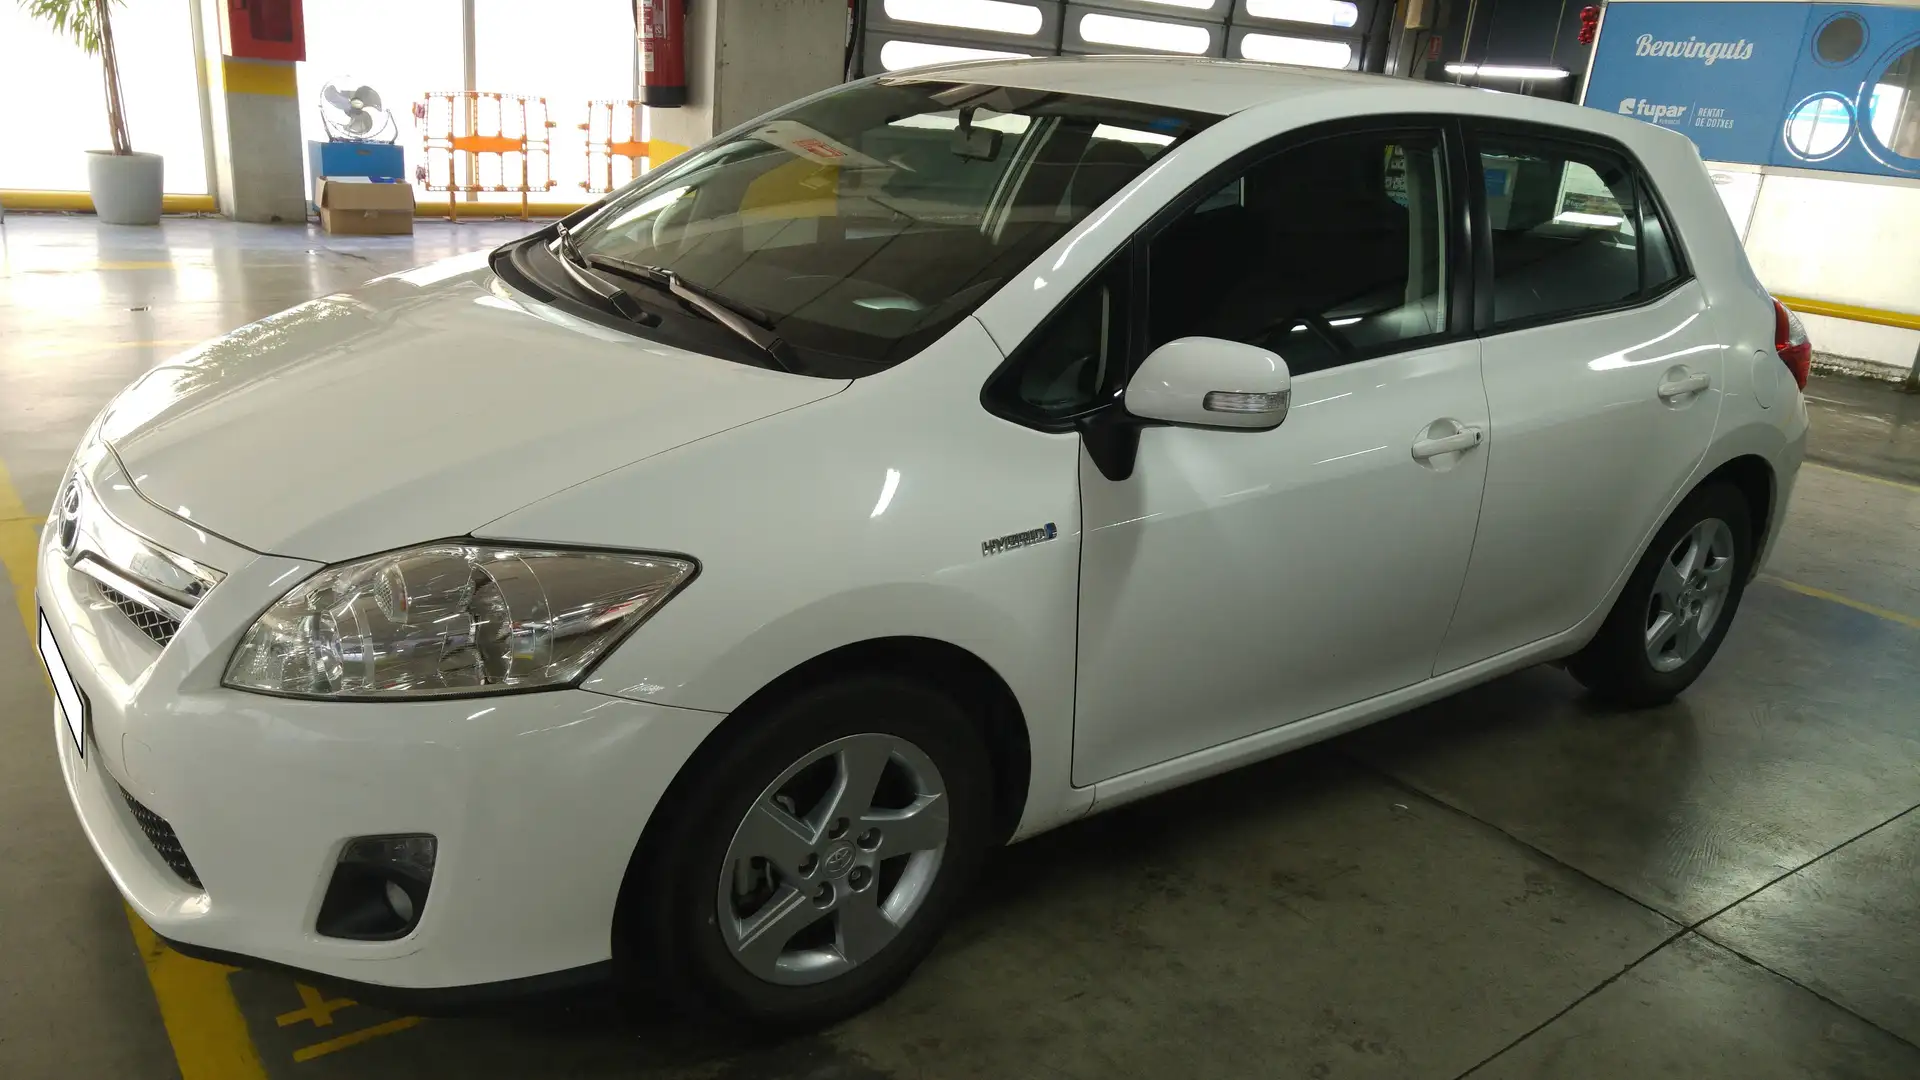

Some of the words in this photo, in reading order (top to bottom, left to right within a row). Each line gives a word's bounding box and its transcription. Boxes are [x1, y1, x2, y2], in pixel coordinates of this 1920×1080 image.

[1635, 33, 1753, 66] Benvinguts
[1637, 98, 1687, 124] fupar
[1695, 118, 1704, 127] DE
[1706, 118, 1734, 129] COTXES
[1698, 107, 1725, 118] RENTAT
[981, 527, 1046, 557] HYBRID
